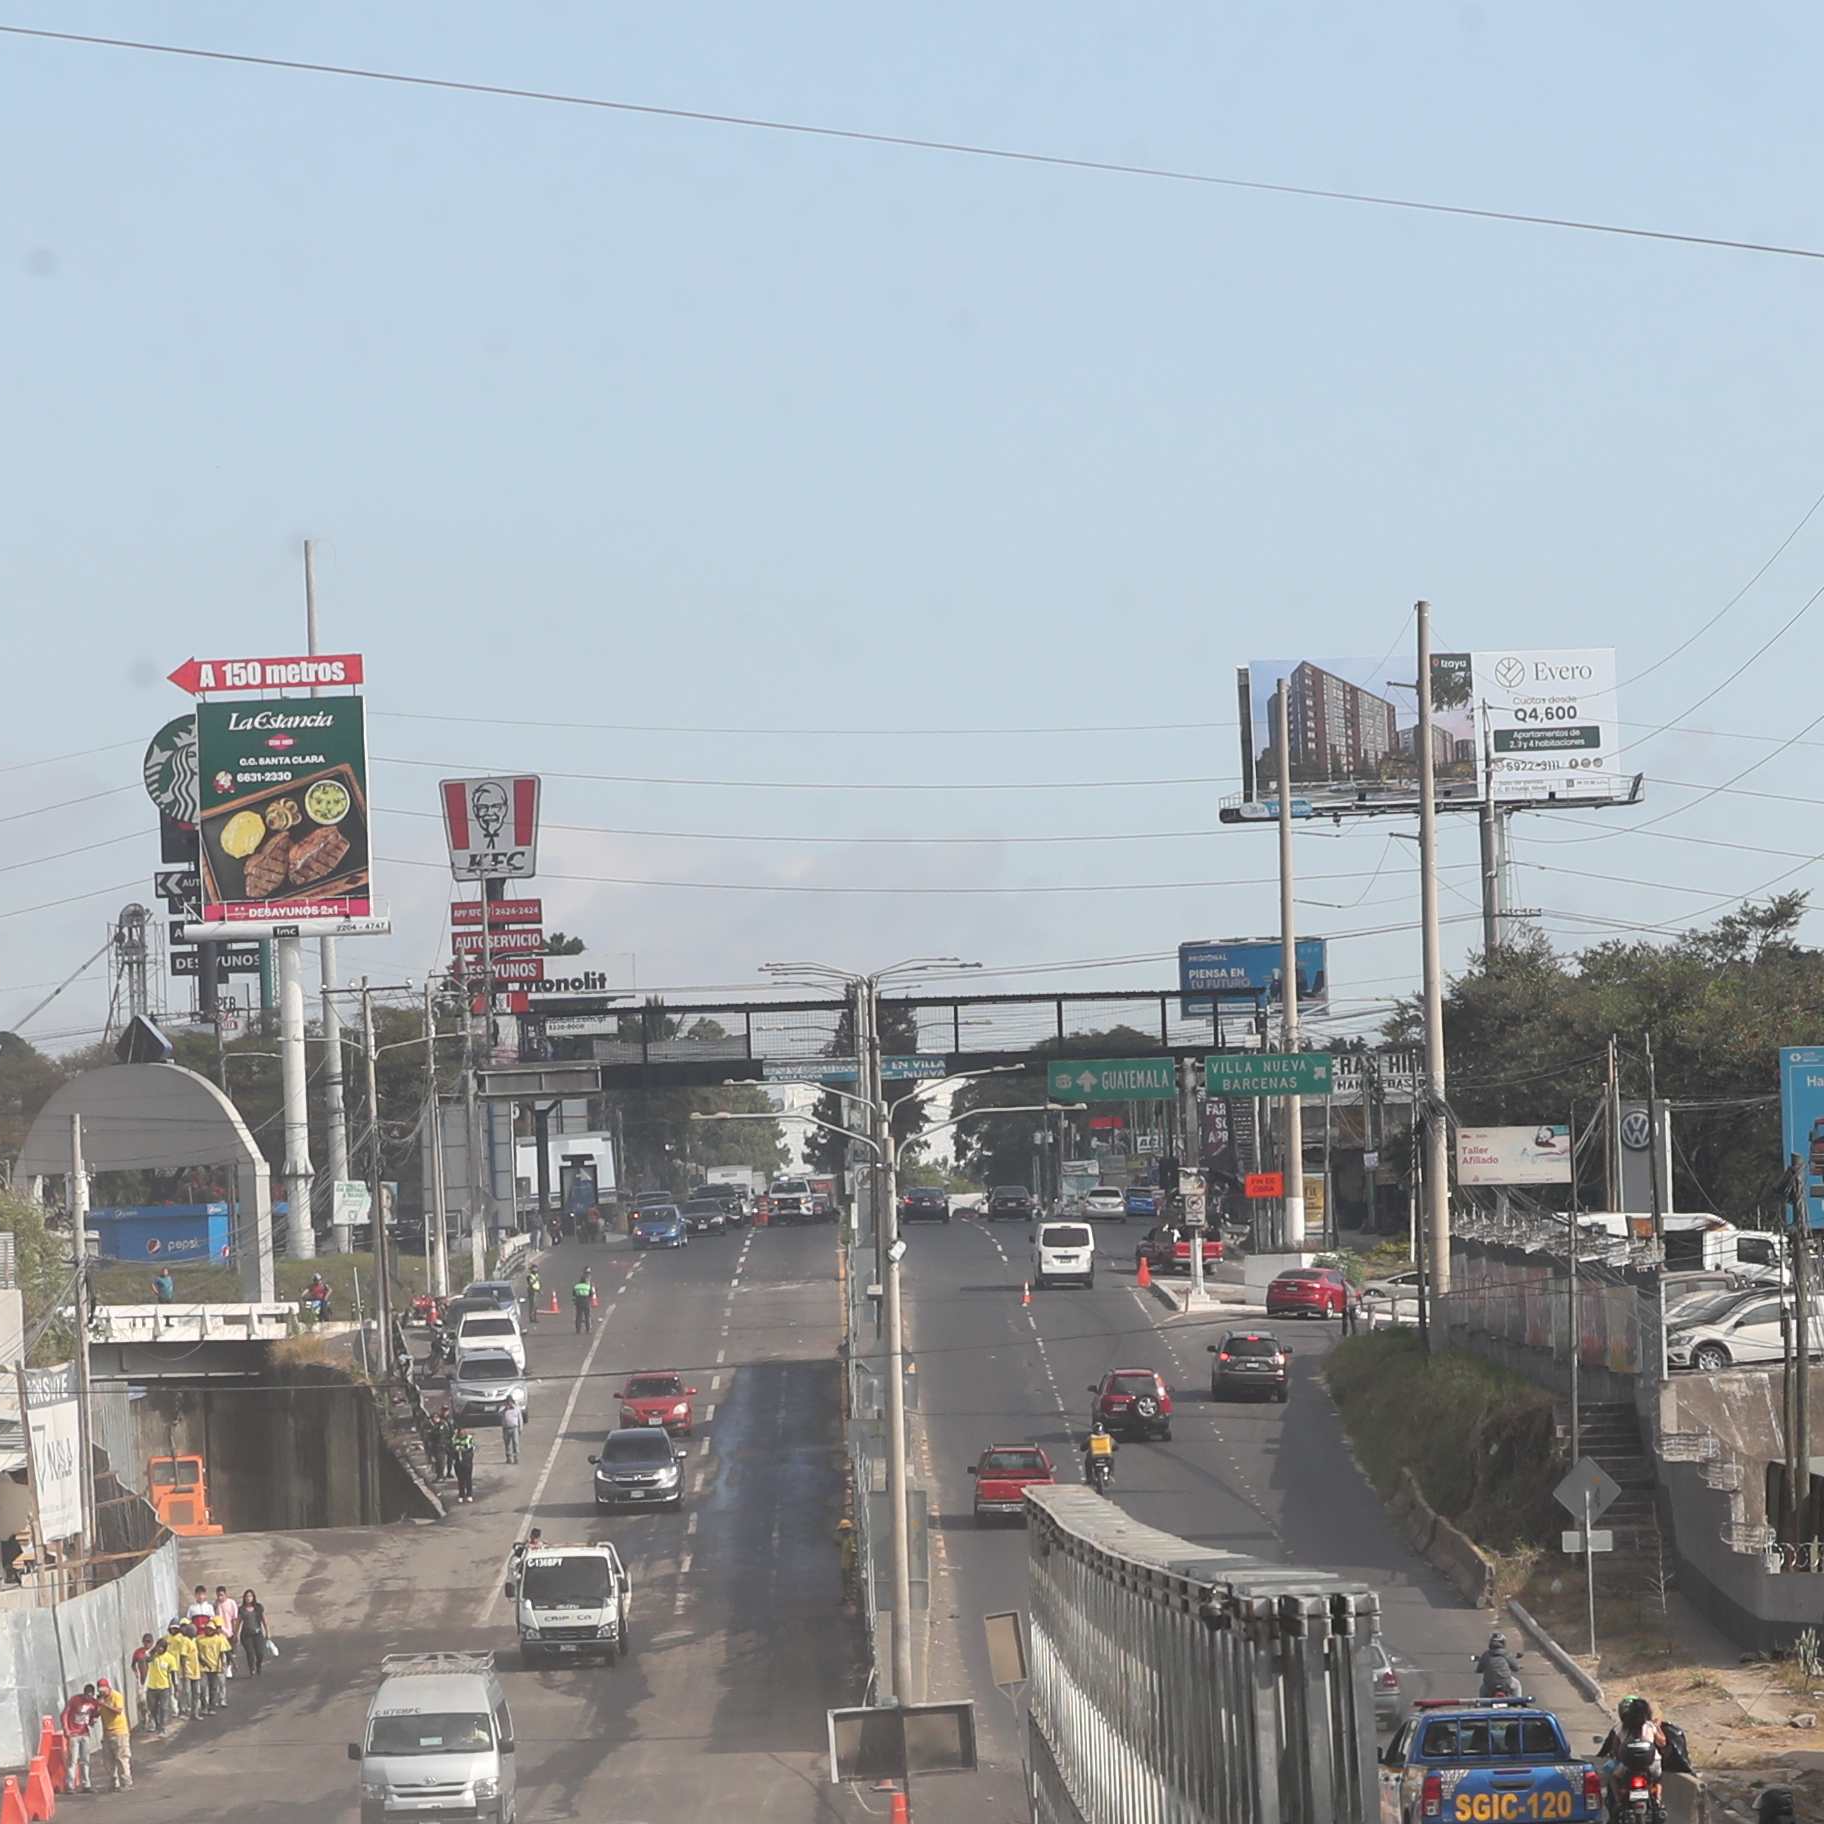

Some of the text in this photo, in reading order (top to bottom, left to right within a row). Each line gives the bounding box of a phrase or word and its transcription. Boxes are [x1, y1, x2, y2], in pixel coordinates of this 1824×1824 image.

[200, 660, 346, 688] A 150 metros
[1533, 661, 1592, 681] Evero
[1514, 704, 1578, 724] Q4,600
[259, 756, 291, 766] SANTA
[292, 755, 326, 765] CLARA
[249, 906, 320, 918] DESAYUNOS
[1188, 967, 1245, 980] PIENSA EN
[1211, 1059, 1308, 1075] VILLA NUEVA
[1101, 1071, 1169, 1090] GUATEMALA
[1222, 1077, 1298, 1091] BARCENAS
[1461, 1146, 1488, 1155] Taller
[1461, 1155, 1499, 1166] Afiliado
[167, 1237, 200, 1252] pepsi
[1455, 1791, 1572, 1822] SGIC-120
